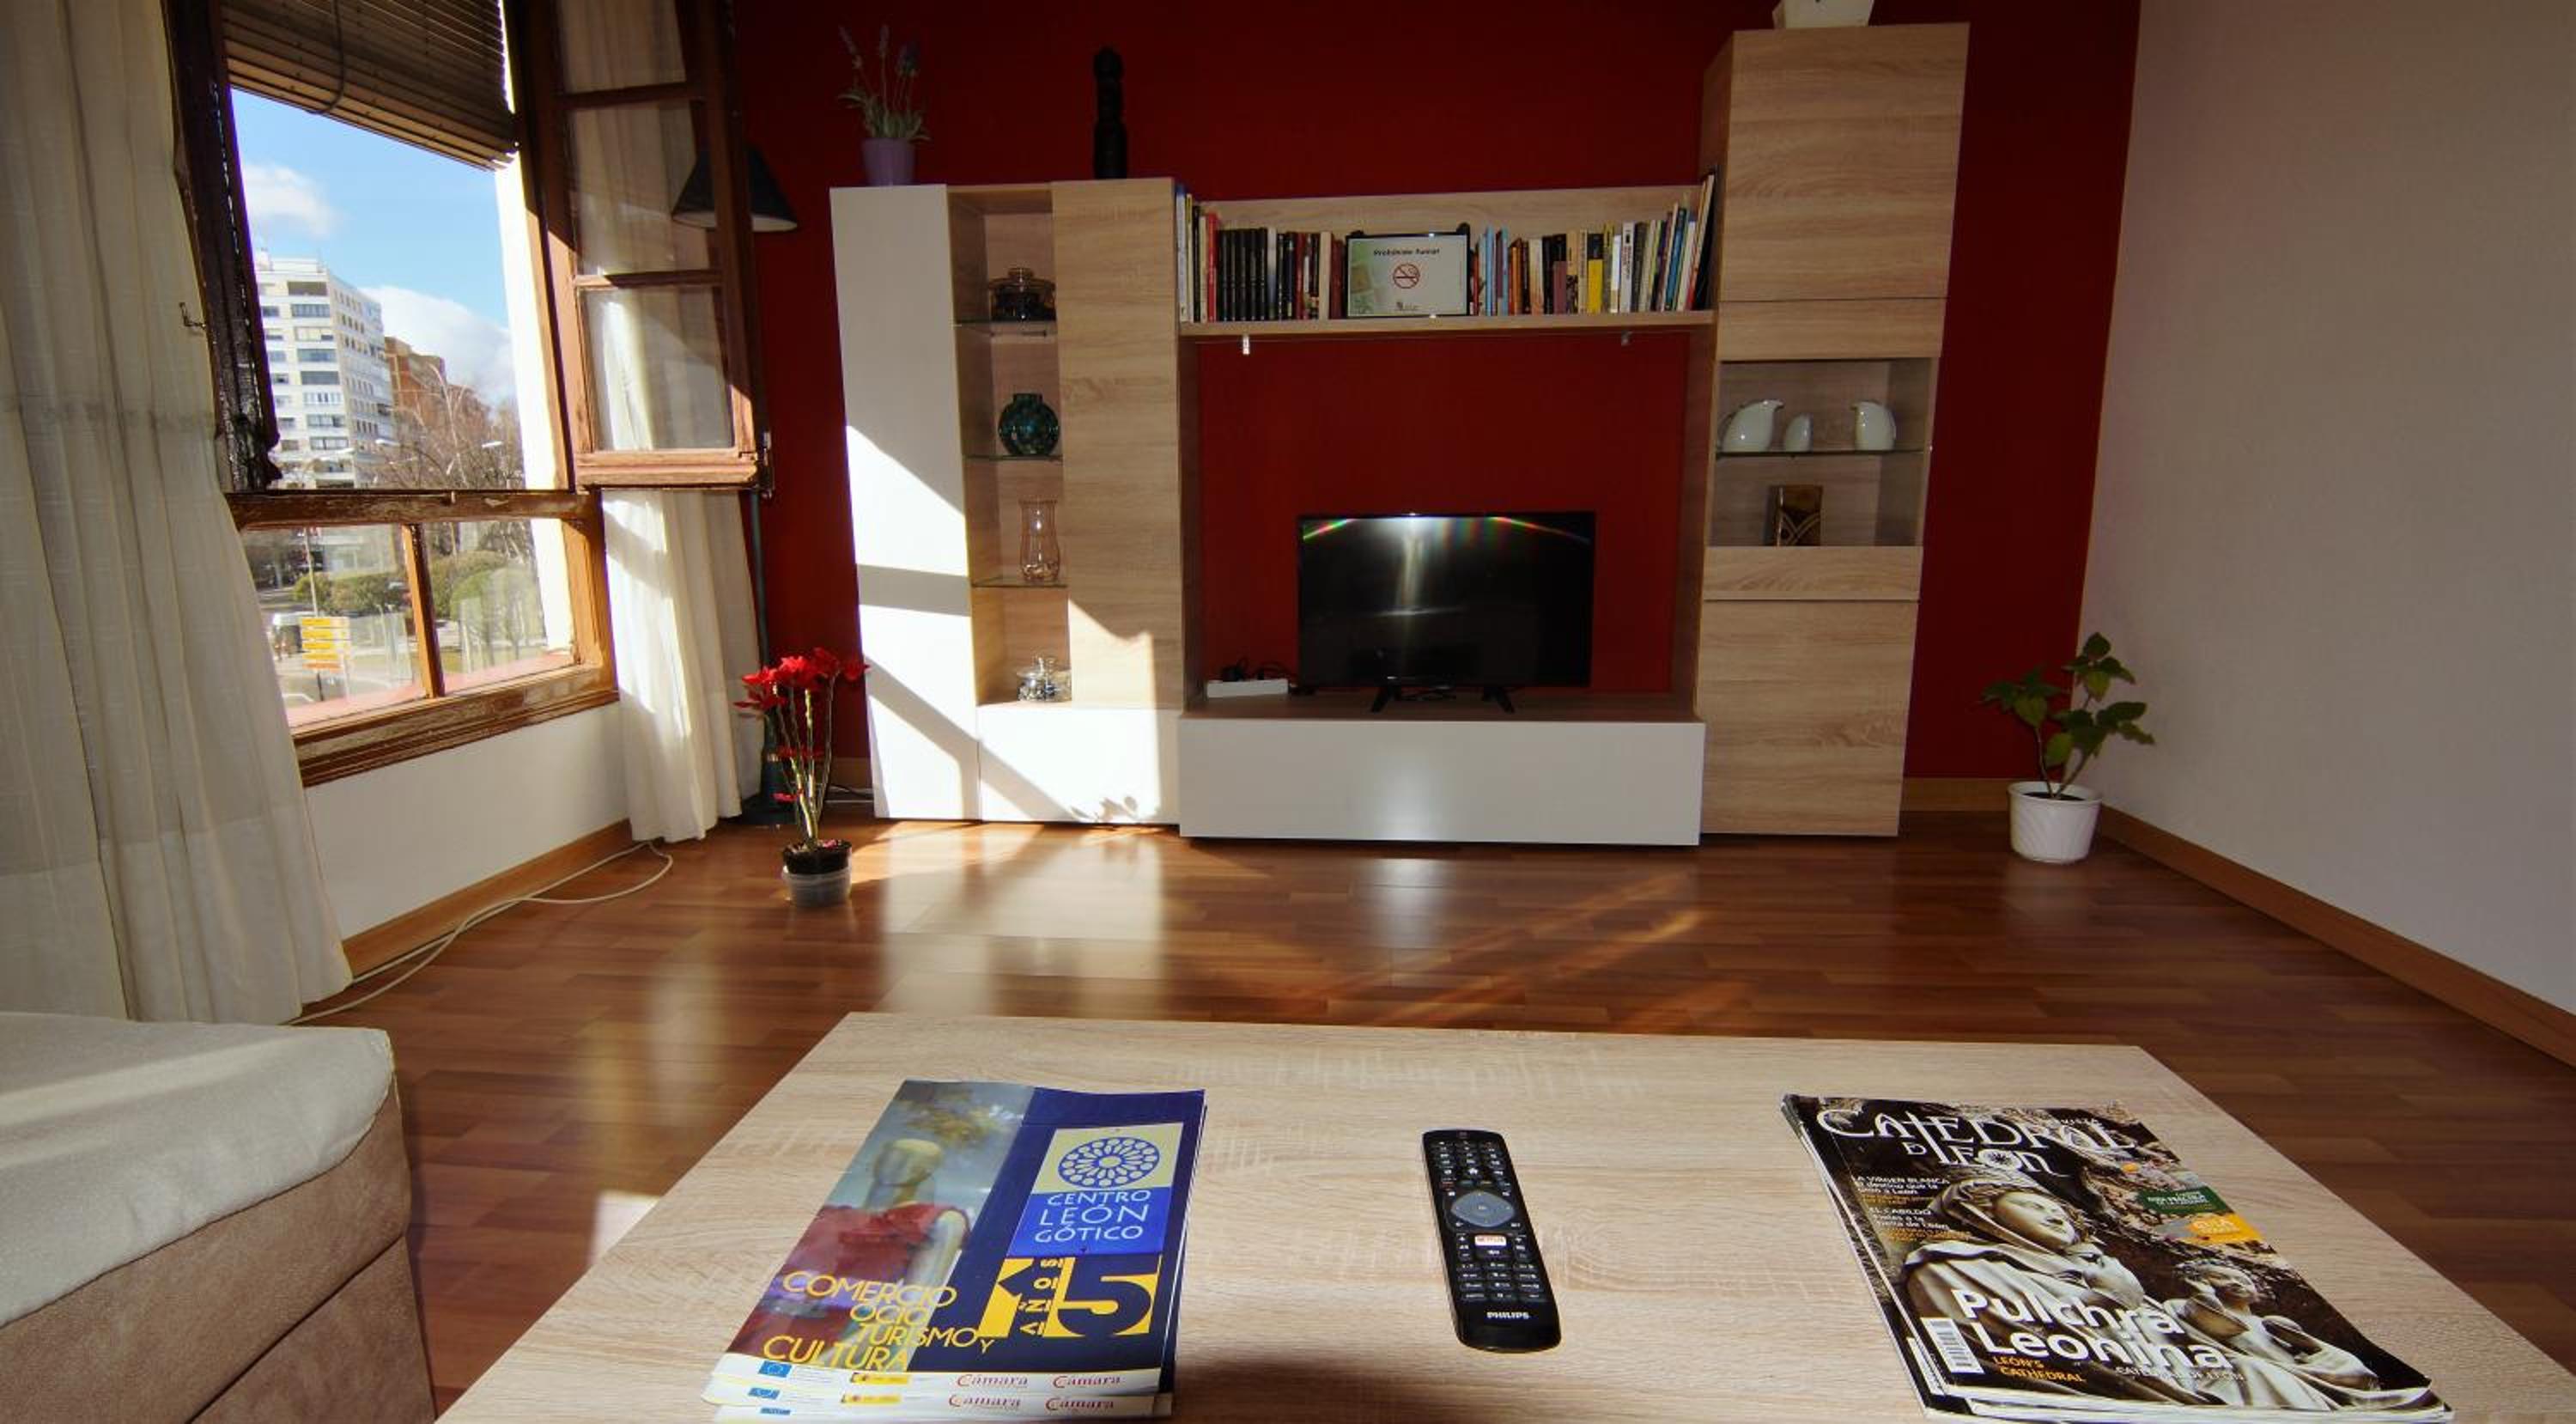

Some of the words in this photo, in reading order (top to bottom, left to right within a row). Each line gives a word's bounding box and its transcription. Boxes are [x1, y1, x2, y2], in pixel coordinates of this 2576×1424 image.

[1047, 1190, 1151, 1207] CENTRO
[1039, 1203, 1150, 1226] LEÓN
[1034, 1224, 1144, 1243] GÓTICO
[782, 1271, 957, 1308] COMERCIO
[849, 1303, 930, 1326] OCIO
[1486, 1311, 1530, 1320] PHILIPS
[1952, 1288, 2185, 1335] Pulchra
[859, 1323, 979, 1348] TURISMO
[1971, 1321, 2234, 1371] Leonina
[762, 1336, 908, 1372] CULTURA
